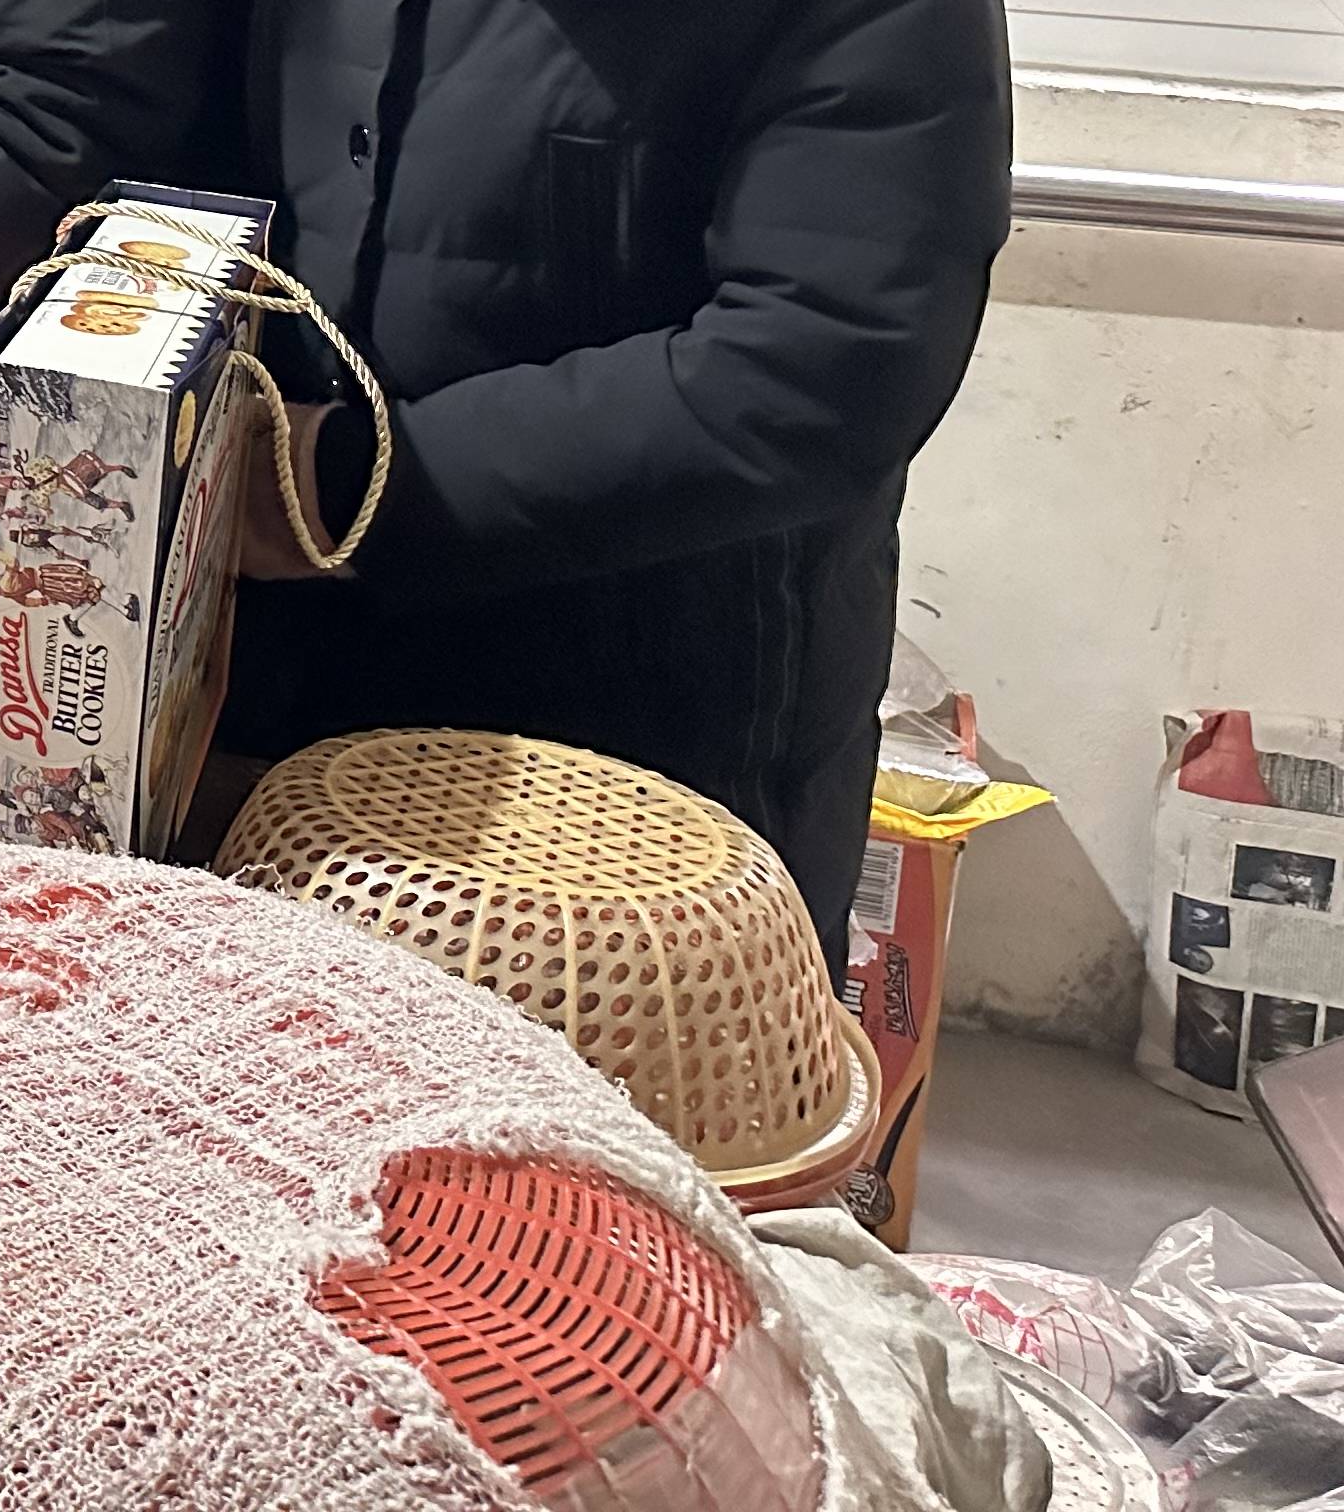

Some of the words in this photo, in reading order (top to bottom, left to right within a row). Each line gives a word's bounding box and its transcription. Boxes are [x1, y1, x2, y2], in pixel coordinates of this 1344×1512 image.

[42, 618, 60, 694] TRADITIONAL
[52, 643, 83, 736] BUTTER
[76, 644, 109, 746] COOKIES
